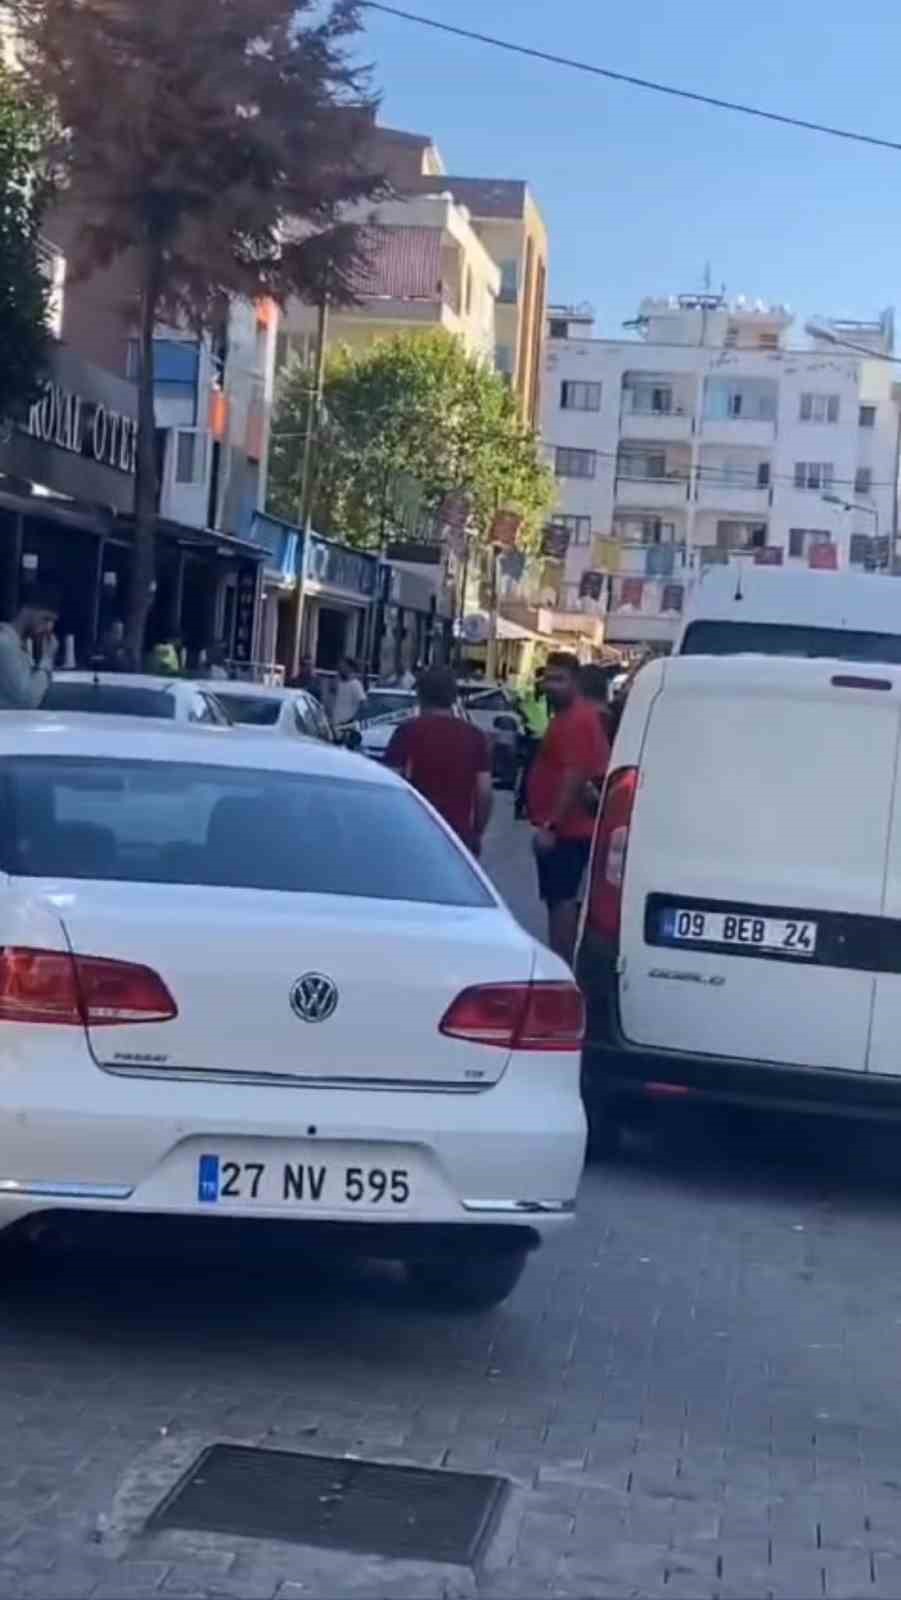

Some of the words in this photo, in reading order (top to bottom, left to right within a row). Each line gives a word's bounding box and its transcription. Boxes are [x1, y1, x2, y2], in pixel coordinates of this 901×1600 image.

[679, 912, 705, 936] 09
[722, 915, 766, 943] BEB
[782, 922, 812, 949] 24
[221, 1162, 265, 1198] 27
[283, 1163, 326, 1201] NV
[345, 1167, 410, 1204] 595
